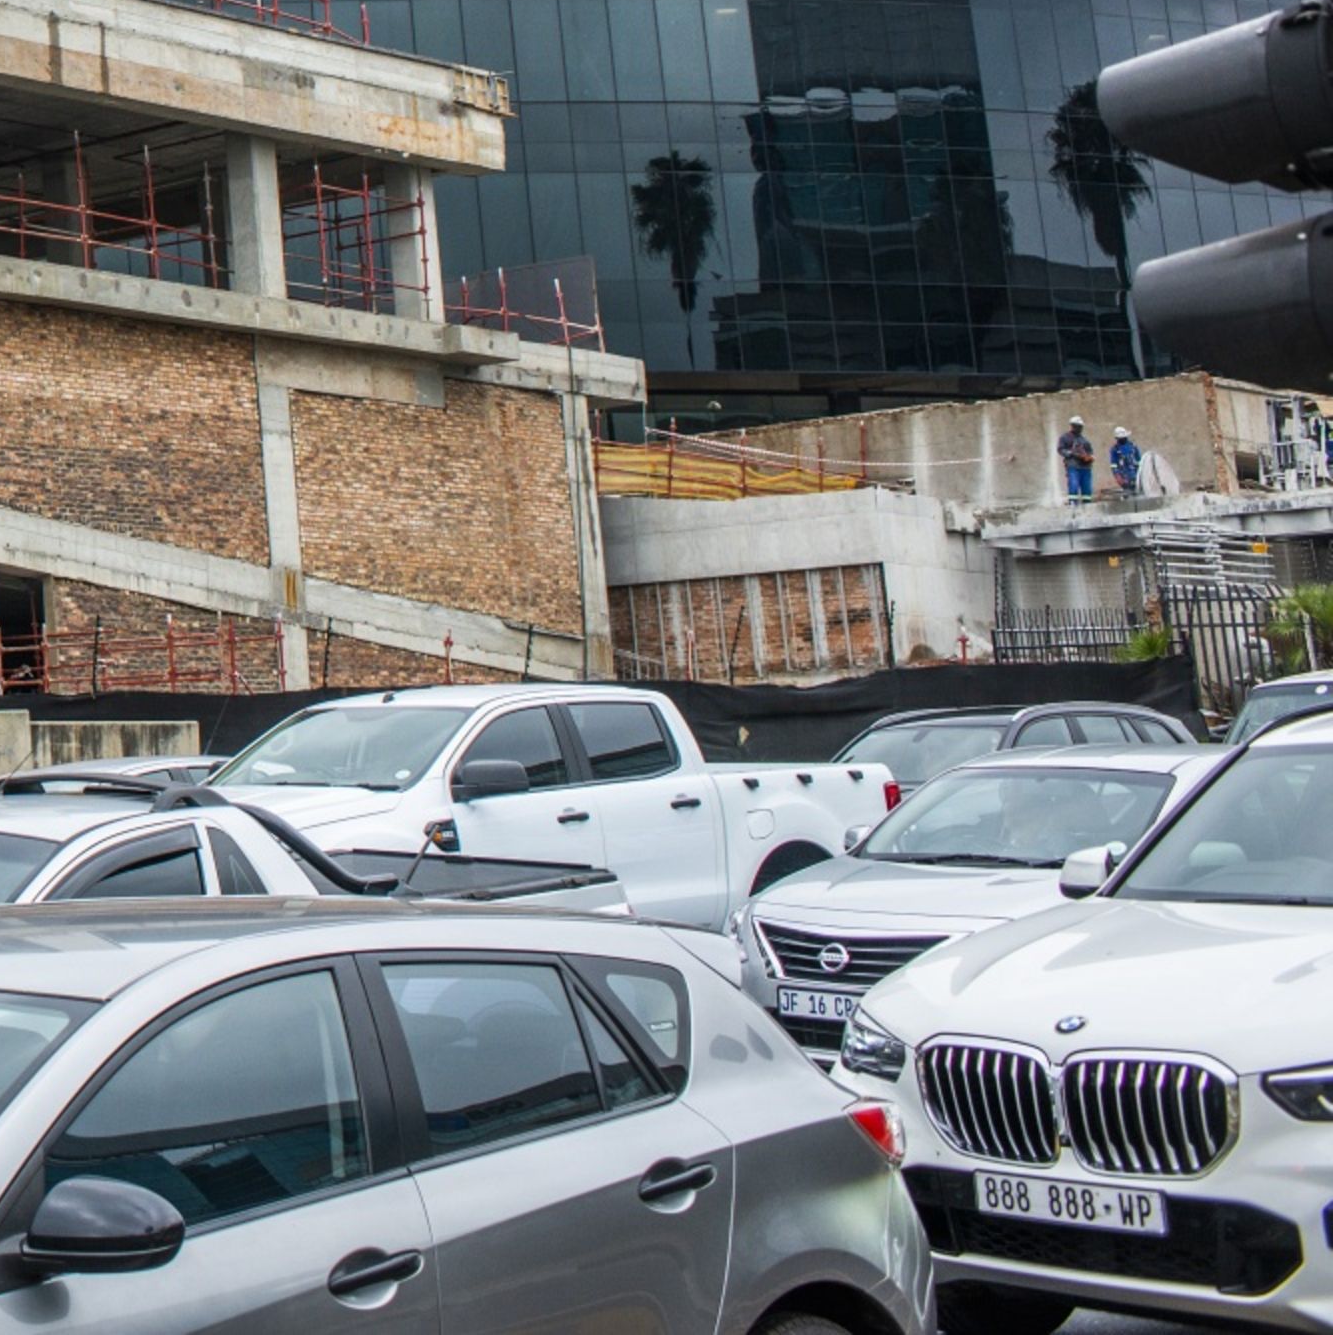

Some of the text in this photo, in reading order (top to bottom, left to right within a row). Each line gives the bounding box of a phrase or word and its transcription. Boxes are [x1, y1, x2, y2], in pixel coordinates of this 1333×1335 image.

[782, 992, 798, 1012] JF
[808, 994, 826, 1015] 16
[985, 1176, 1152, 1227] 888 888 WP
